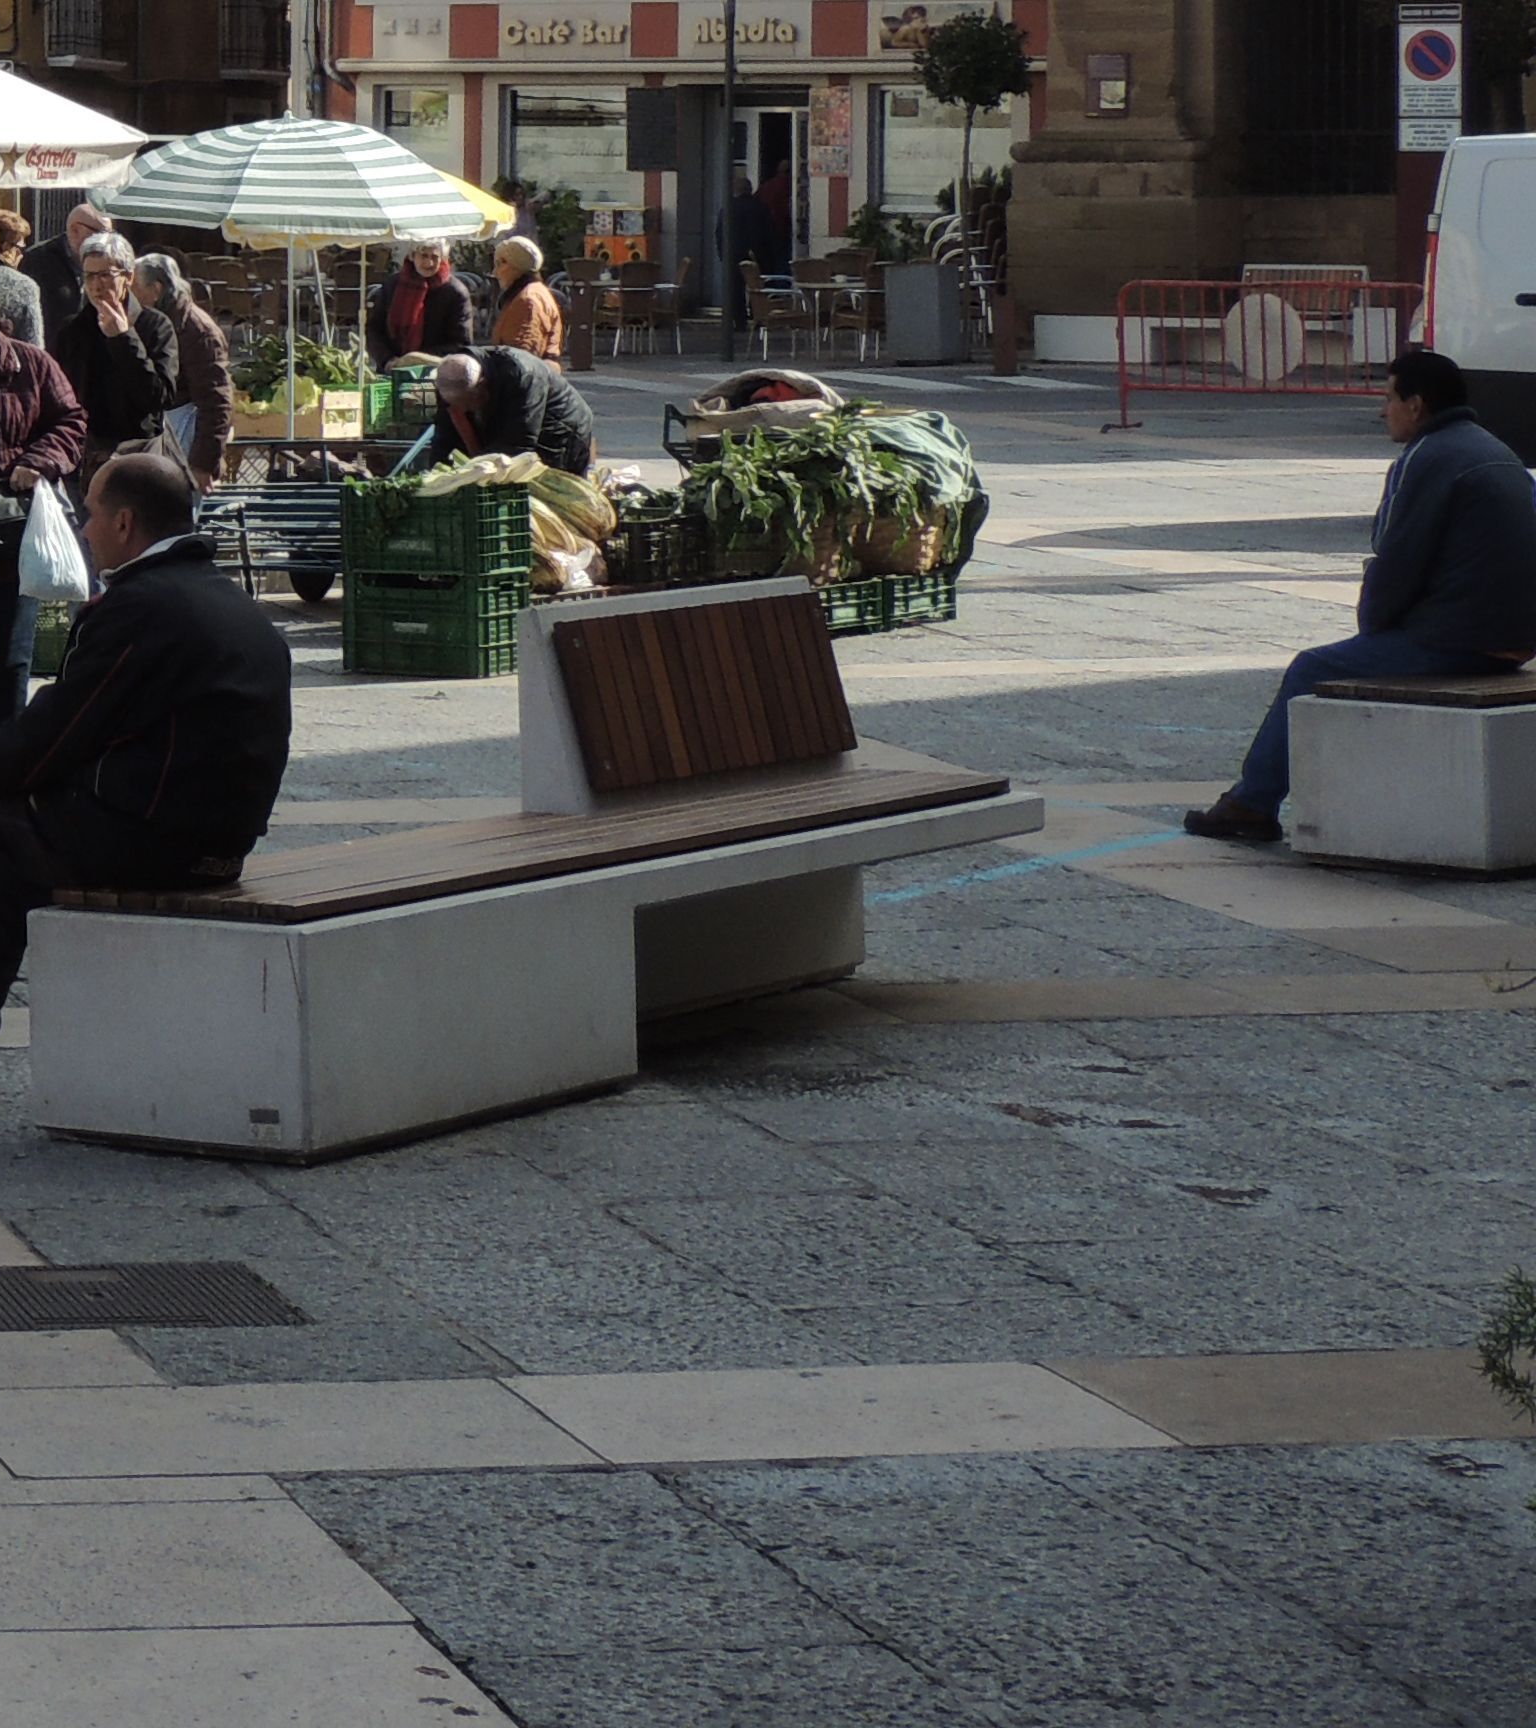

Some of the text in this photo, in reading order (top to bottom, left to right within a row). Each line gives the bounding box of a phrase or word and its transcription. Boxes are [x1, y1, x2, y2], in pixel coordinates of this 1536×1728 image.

[505, 18, 573, 45] Café
[580, 19, 626, 45] Bar
[26, 144, 77, 168] Estrella
